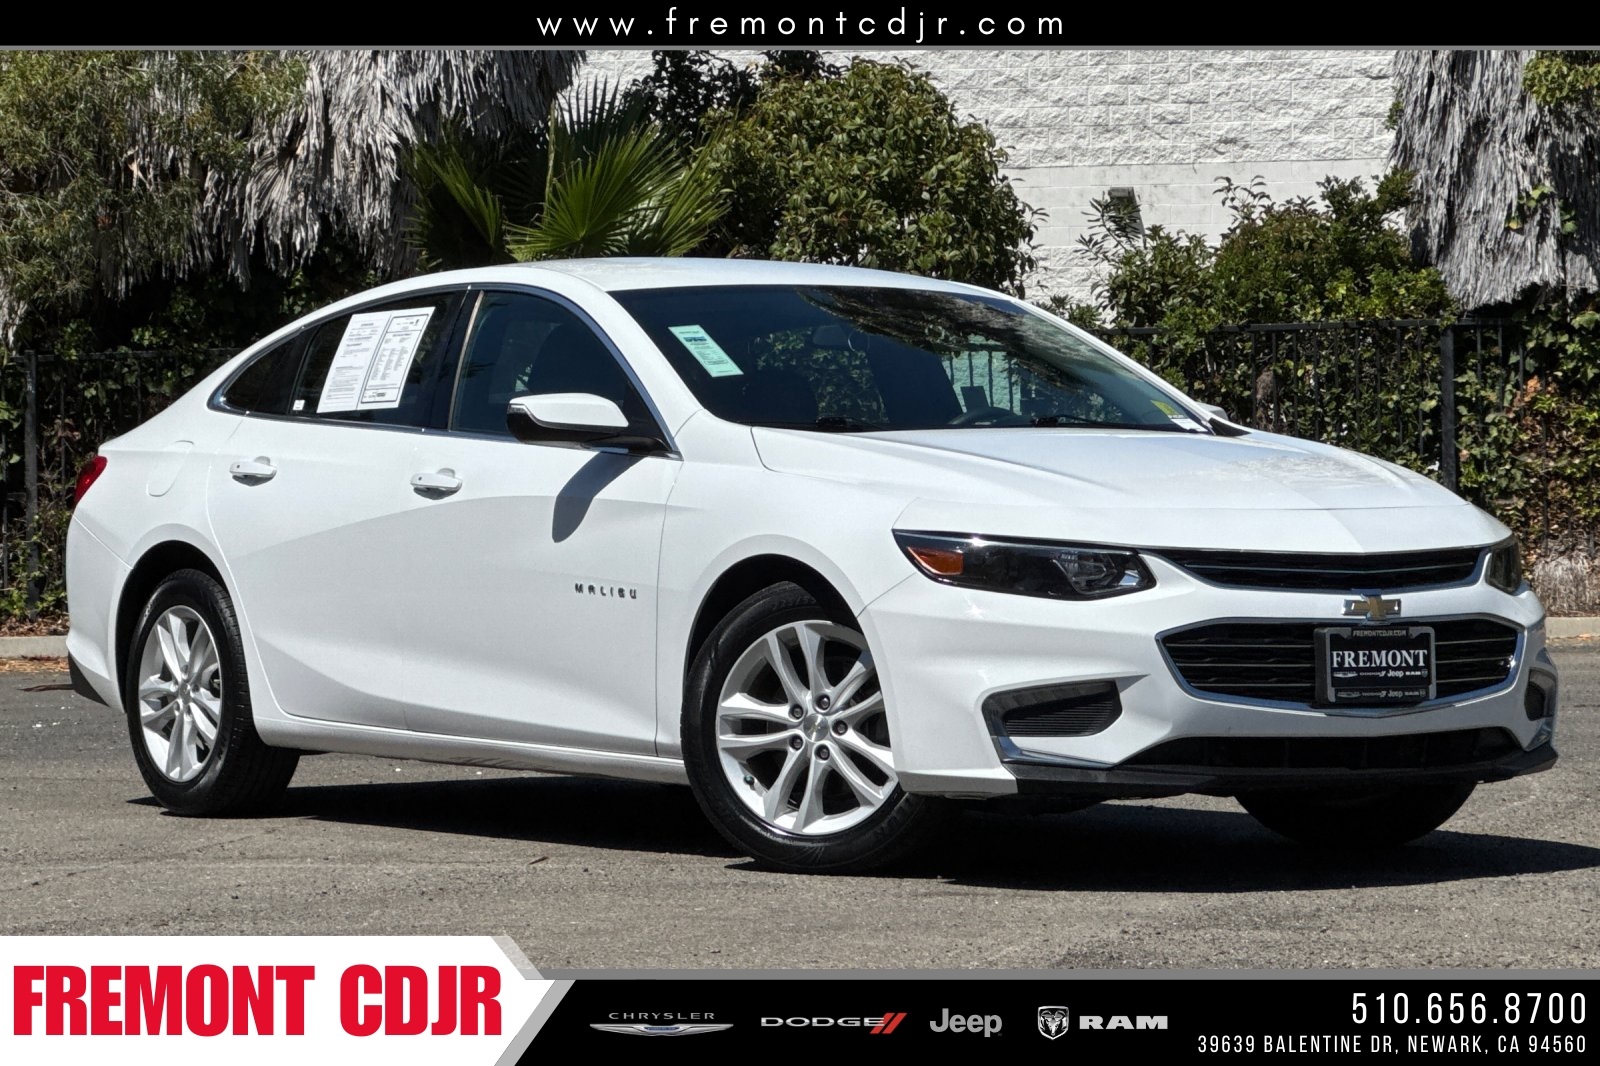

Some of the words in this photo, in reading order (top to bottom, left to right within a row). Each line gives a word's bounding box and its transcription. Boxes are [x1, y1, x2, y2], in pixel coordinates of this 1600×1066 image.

[574, 583, 637, 599] MALIBU
[1331, 649, 1428, 668] FREMONT
[1387, 669, 1404, 678] Jeep
